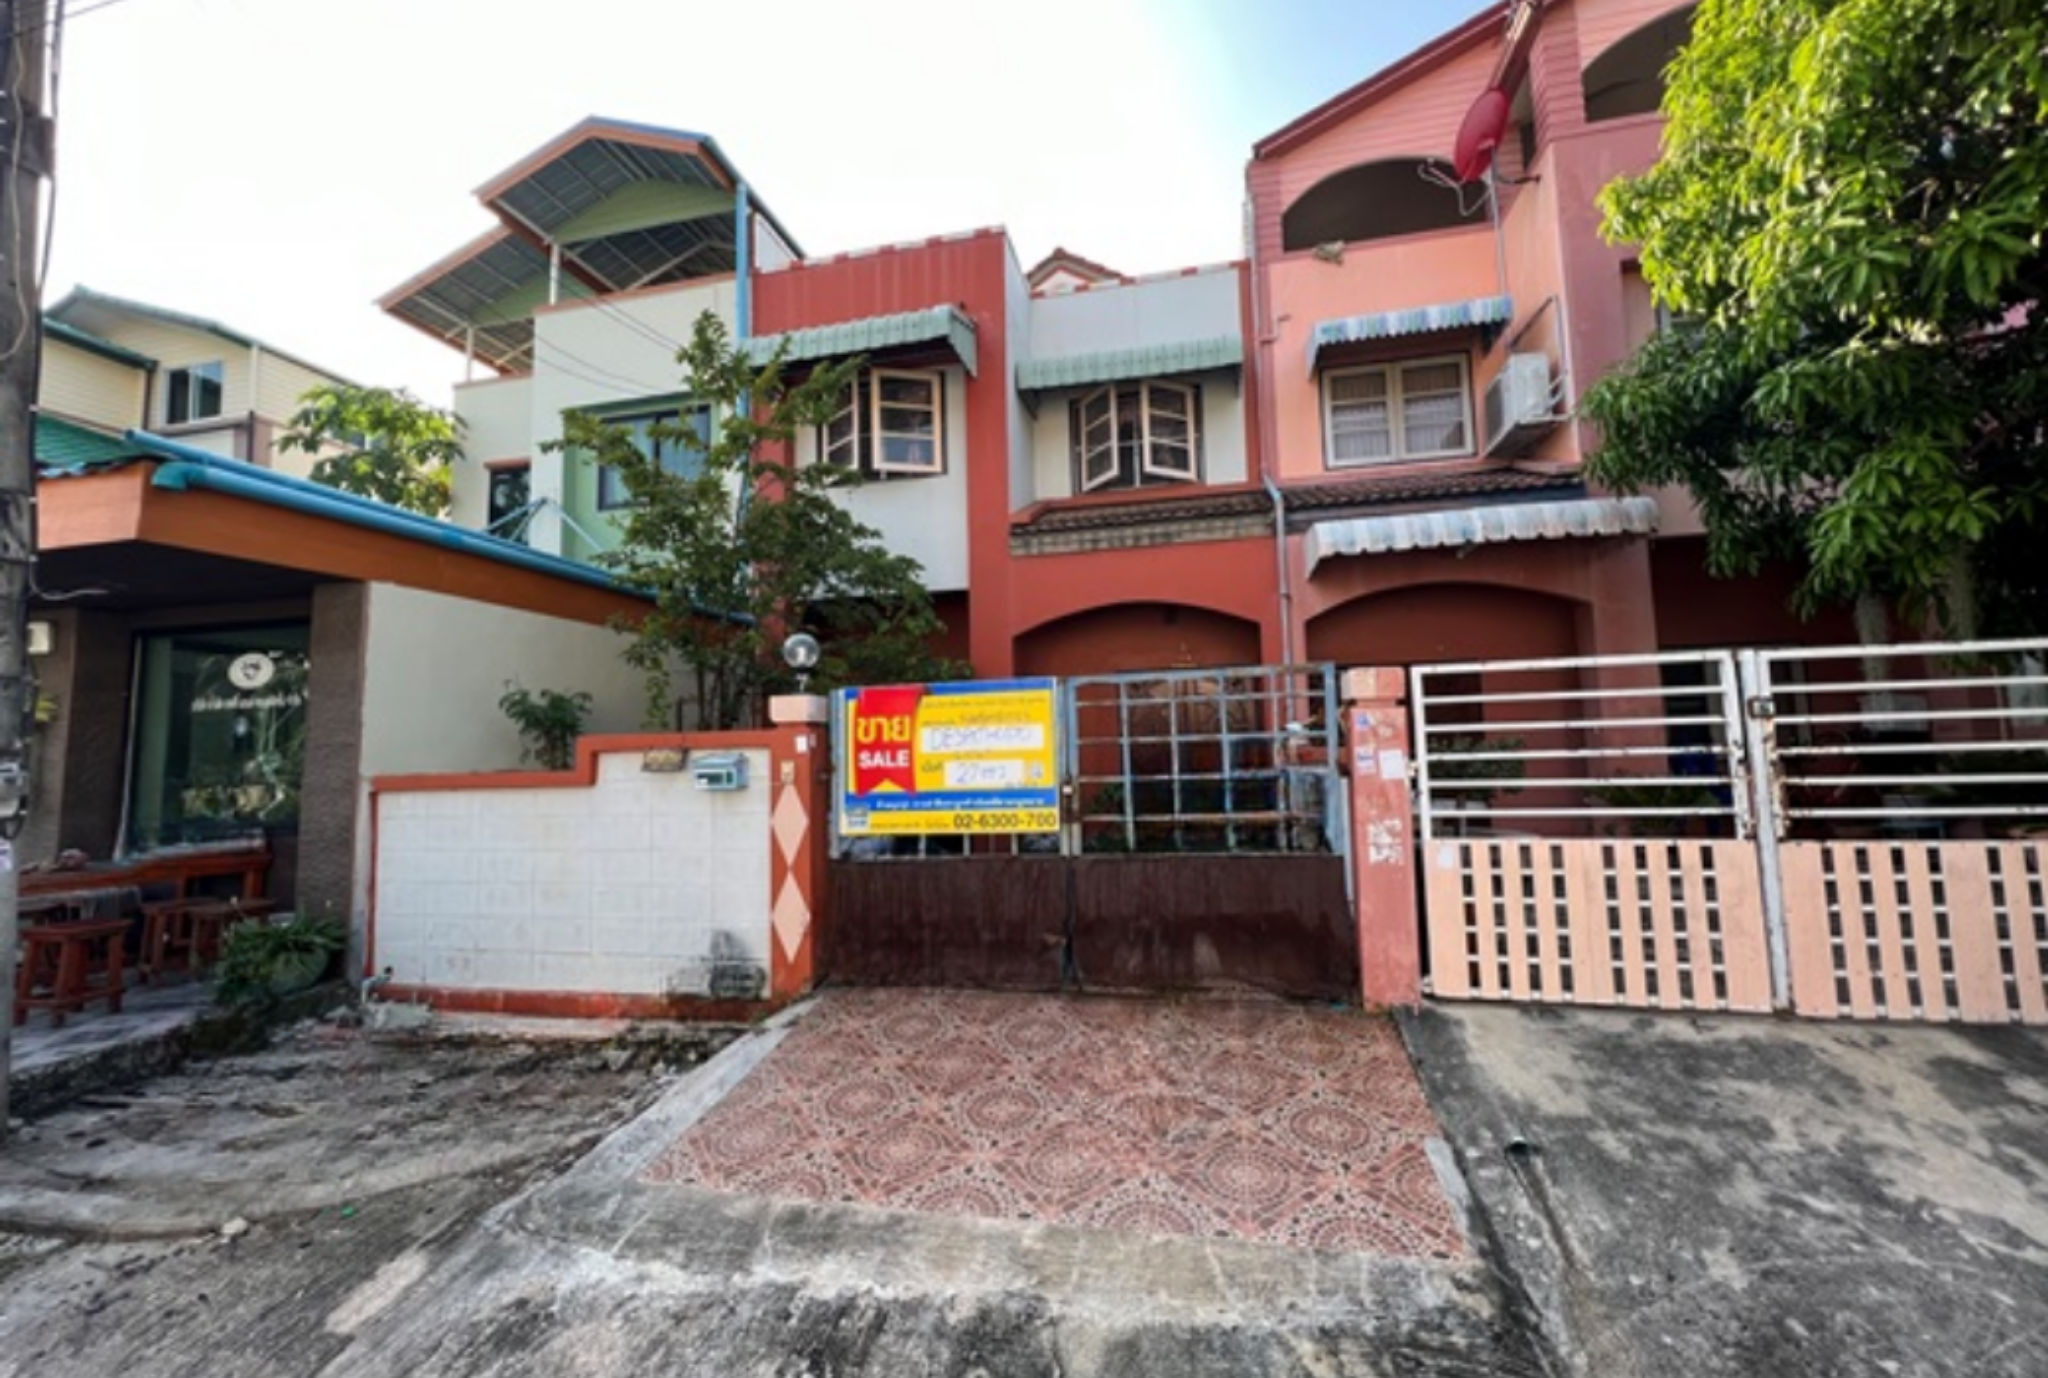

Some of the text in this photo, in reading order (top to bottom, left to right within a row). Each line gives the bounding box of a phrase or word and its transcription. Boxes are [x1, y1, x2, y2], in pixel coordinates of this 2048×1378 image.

[857, 716, 910, 743] ขาย
[858, 749, 910, 769] SALE
[953, 811, 1057, 829] 02-6300-700
